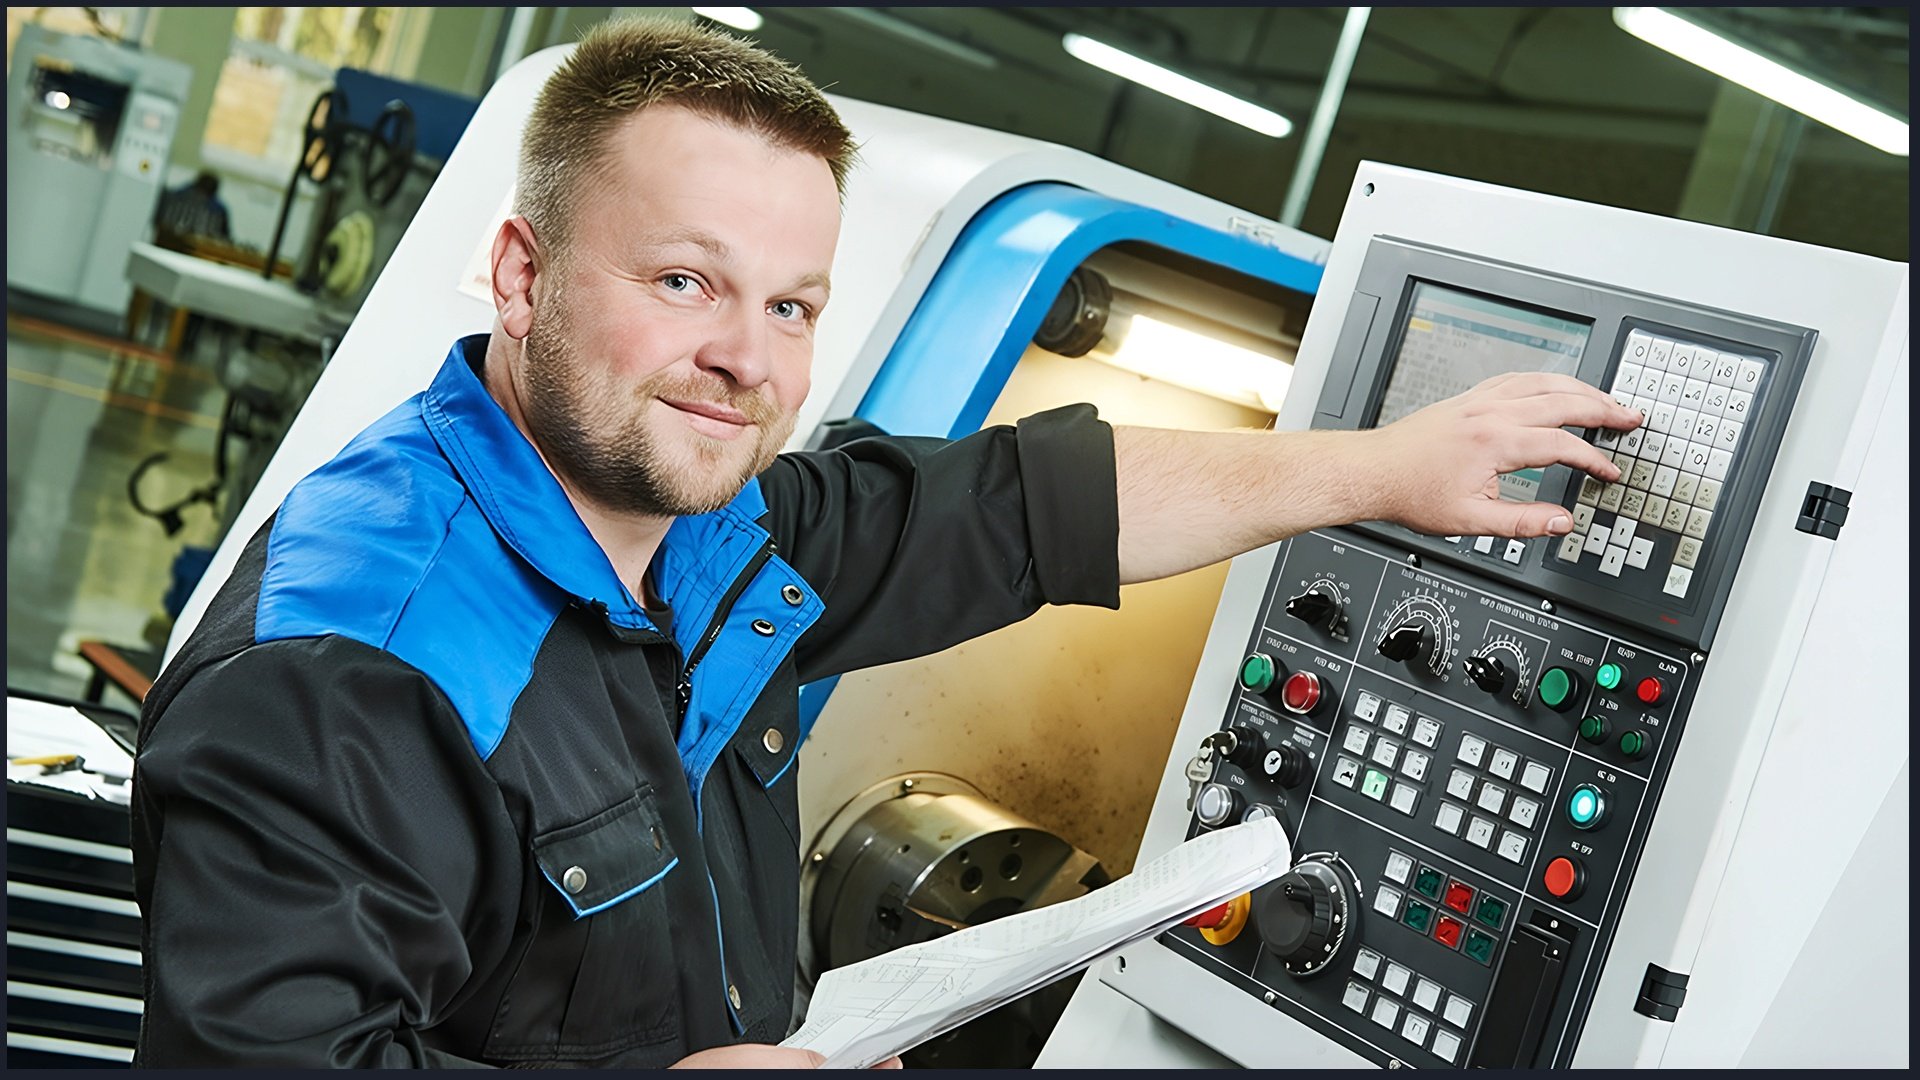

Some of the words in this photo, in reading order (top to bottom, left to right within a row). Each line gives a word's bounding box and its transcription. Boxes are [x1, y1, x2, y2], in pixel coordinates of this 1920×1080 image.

[1702, 360, 1711, 371] 7
[1746, 371, 1756, 382] 9
[1725, 429, 1736, 442] 3
